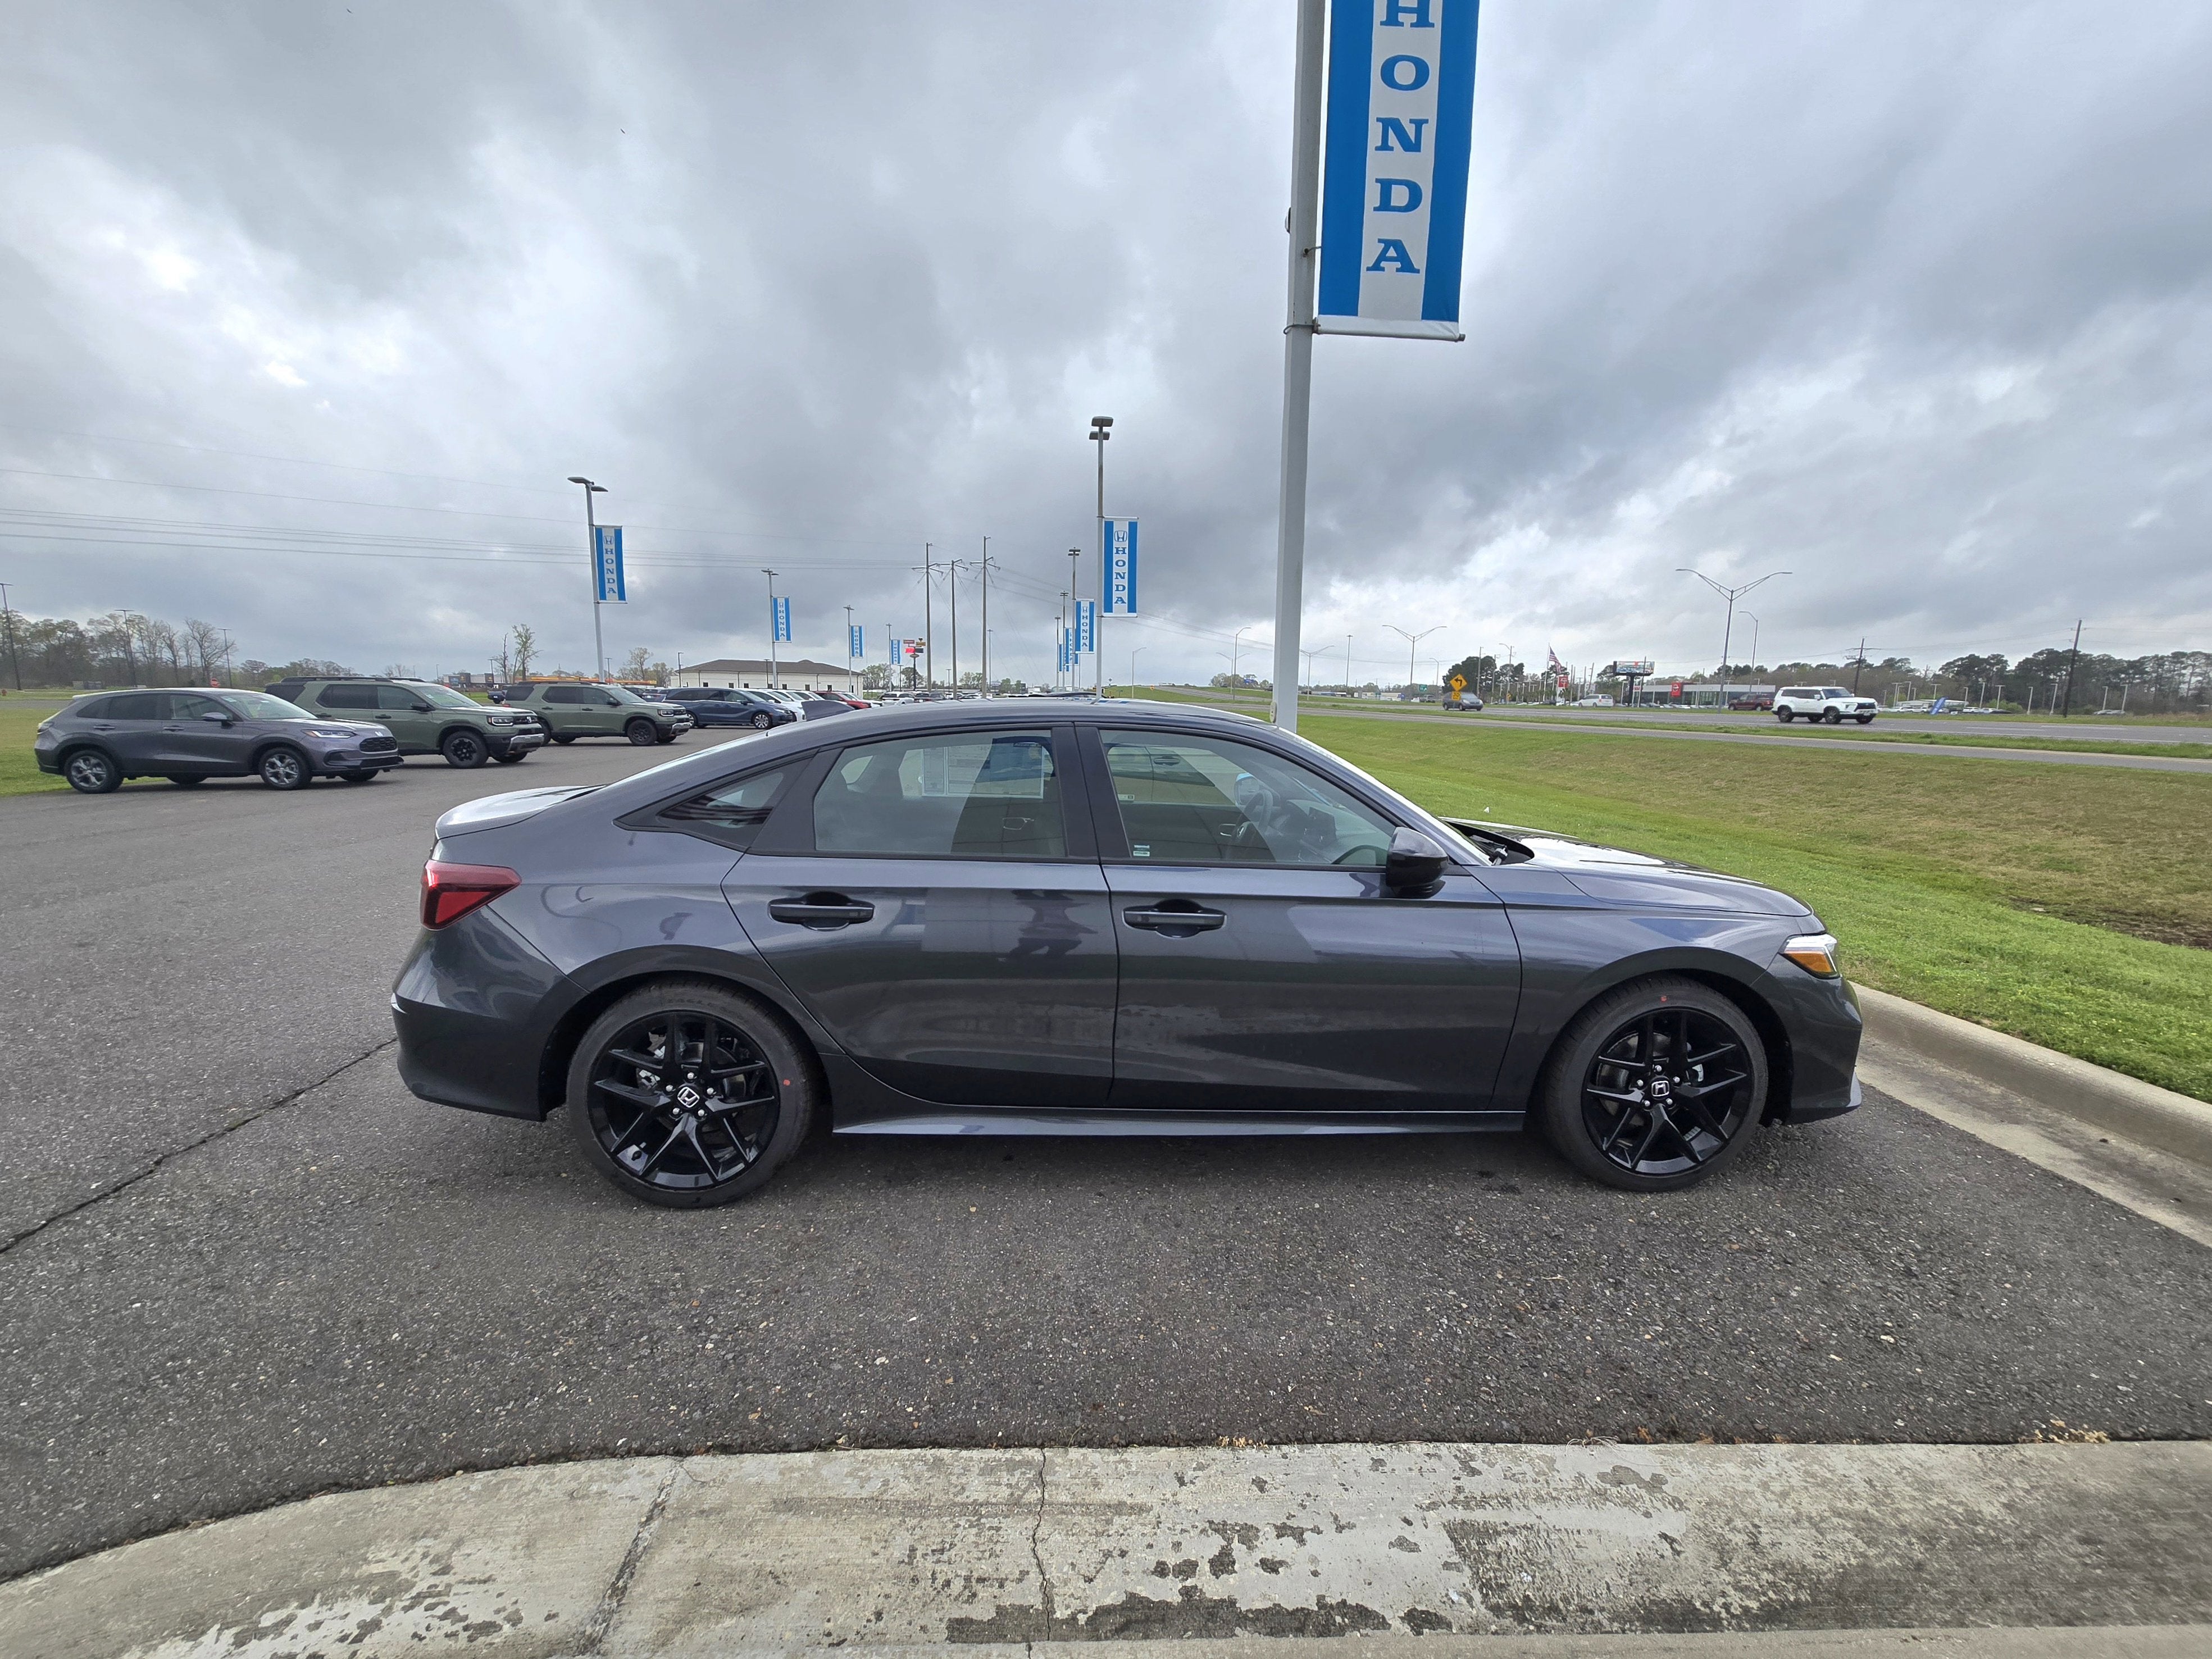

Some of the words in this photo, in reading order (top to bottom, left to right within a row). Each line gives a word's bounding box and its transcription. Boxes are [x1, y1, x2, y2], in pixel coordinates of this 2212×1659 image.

[1366, 0, 1435, 274] HONDA
[604, 548, 617, 594] HONDA
[1114, 546, 1127, 604] HONDA
